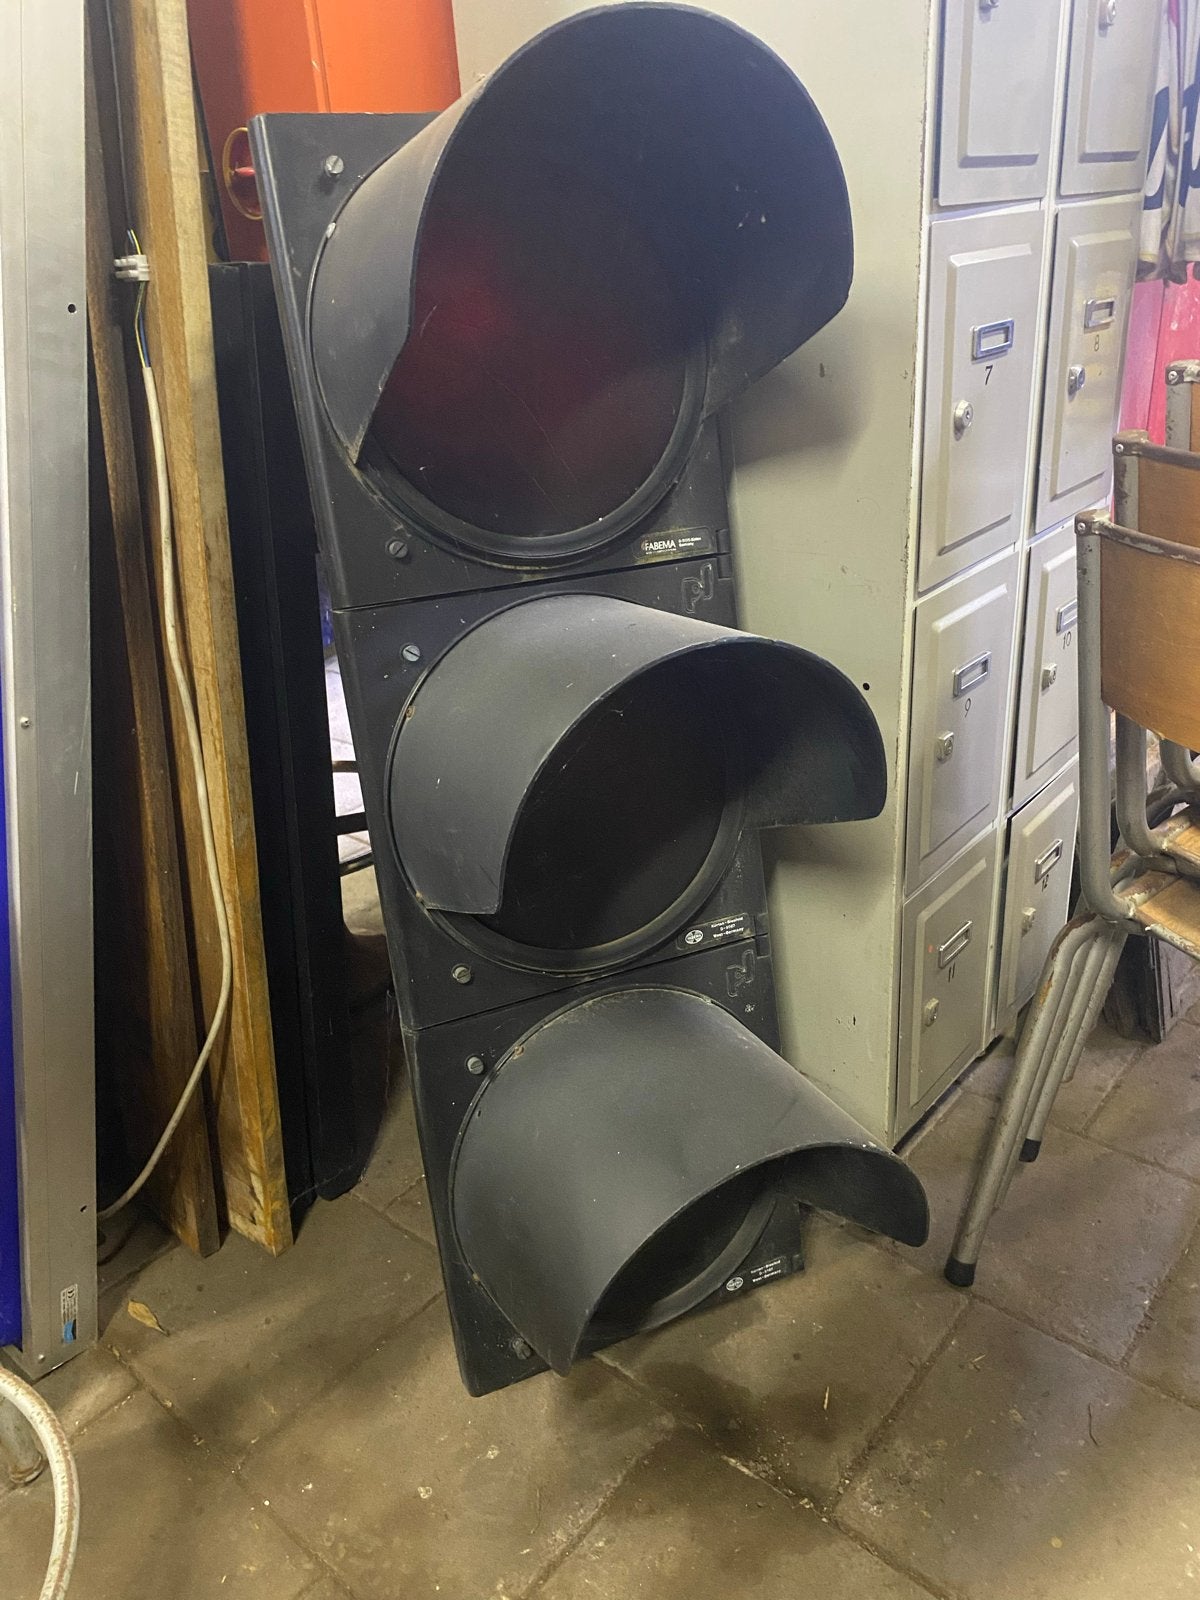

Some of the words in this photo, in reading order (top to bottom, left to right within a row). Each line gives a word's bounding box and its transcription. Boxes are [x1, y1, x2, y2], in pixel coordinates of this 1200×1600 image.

[1093, 334, 1100, 352] 8
[985, 365, 993, 385] 7
[645, 540, 676, 551] FABEMA
[1062, 631, 1072, 649] 10
[964, 698, 972, 718] 9
[948, 962, 955, 982] 11
